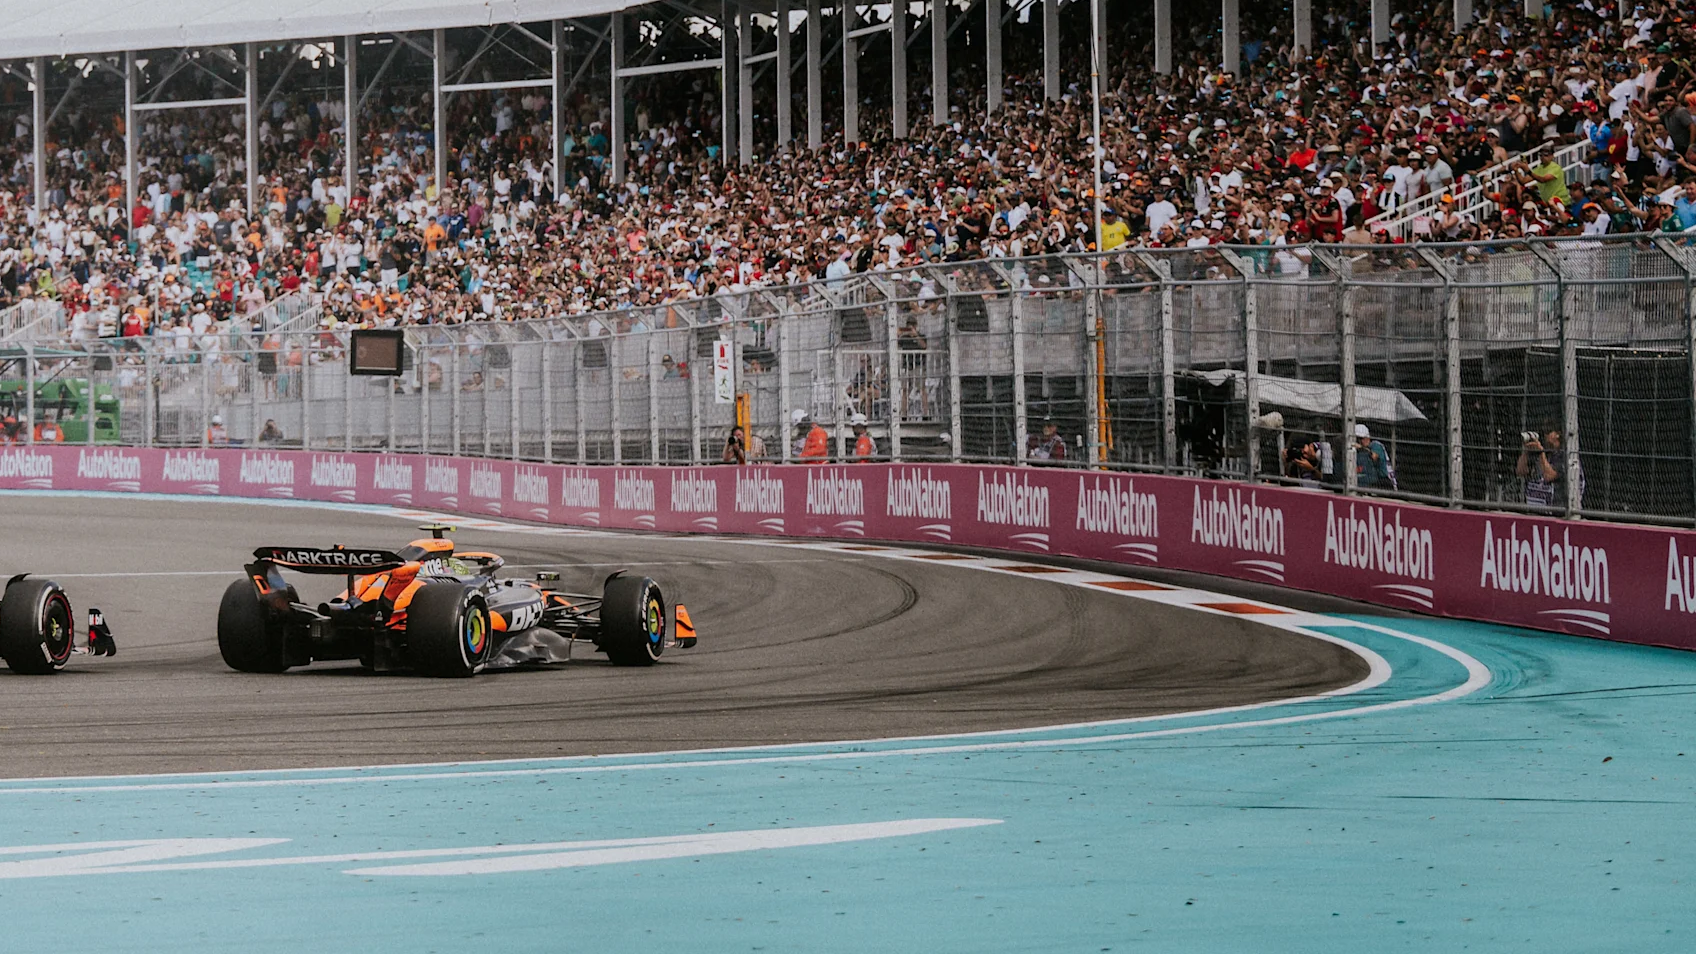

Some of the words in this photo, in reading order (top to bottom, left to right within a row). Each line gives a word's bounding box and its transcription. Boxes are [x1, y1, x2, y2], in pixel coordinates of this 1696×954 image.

[77, 450, 140, 479] AutoNation
[162, 451, 219, 481] AutoNation
[240, 452, 294, 484] AutoNation
[311, 454, 356, 487] AutoNation
[614, 469, 655, 511] AutoNation
[671, 469, 718, 513] AutoNation
[735, 468, 784, 513] AutoNation
[806, 467, 864, 515] AutoNation
[886, 467, 951, 519] AutoNation
[977, 470, 1049, 528] AutoNation
[1076, 475, 1158, 537] AutoNation
[1191, 484, 1284, 556] AutoNation
[1324, 500, 1434, 581] AutoNation
[273, 551, 382, 566] DARKTRACE
[1480, 520, 1610, 603] AutoNation
